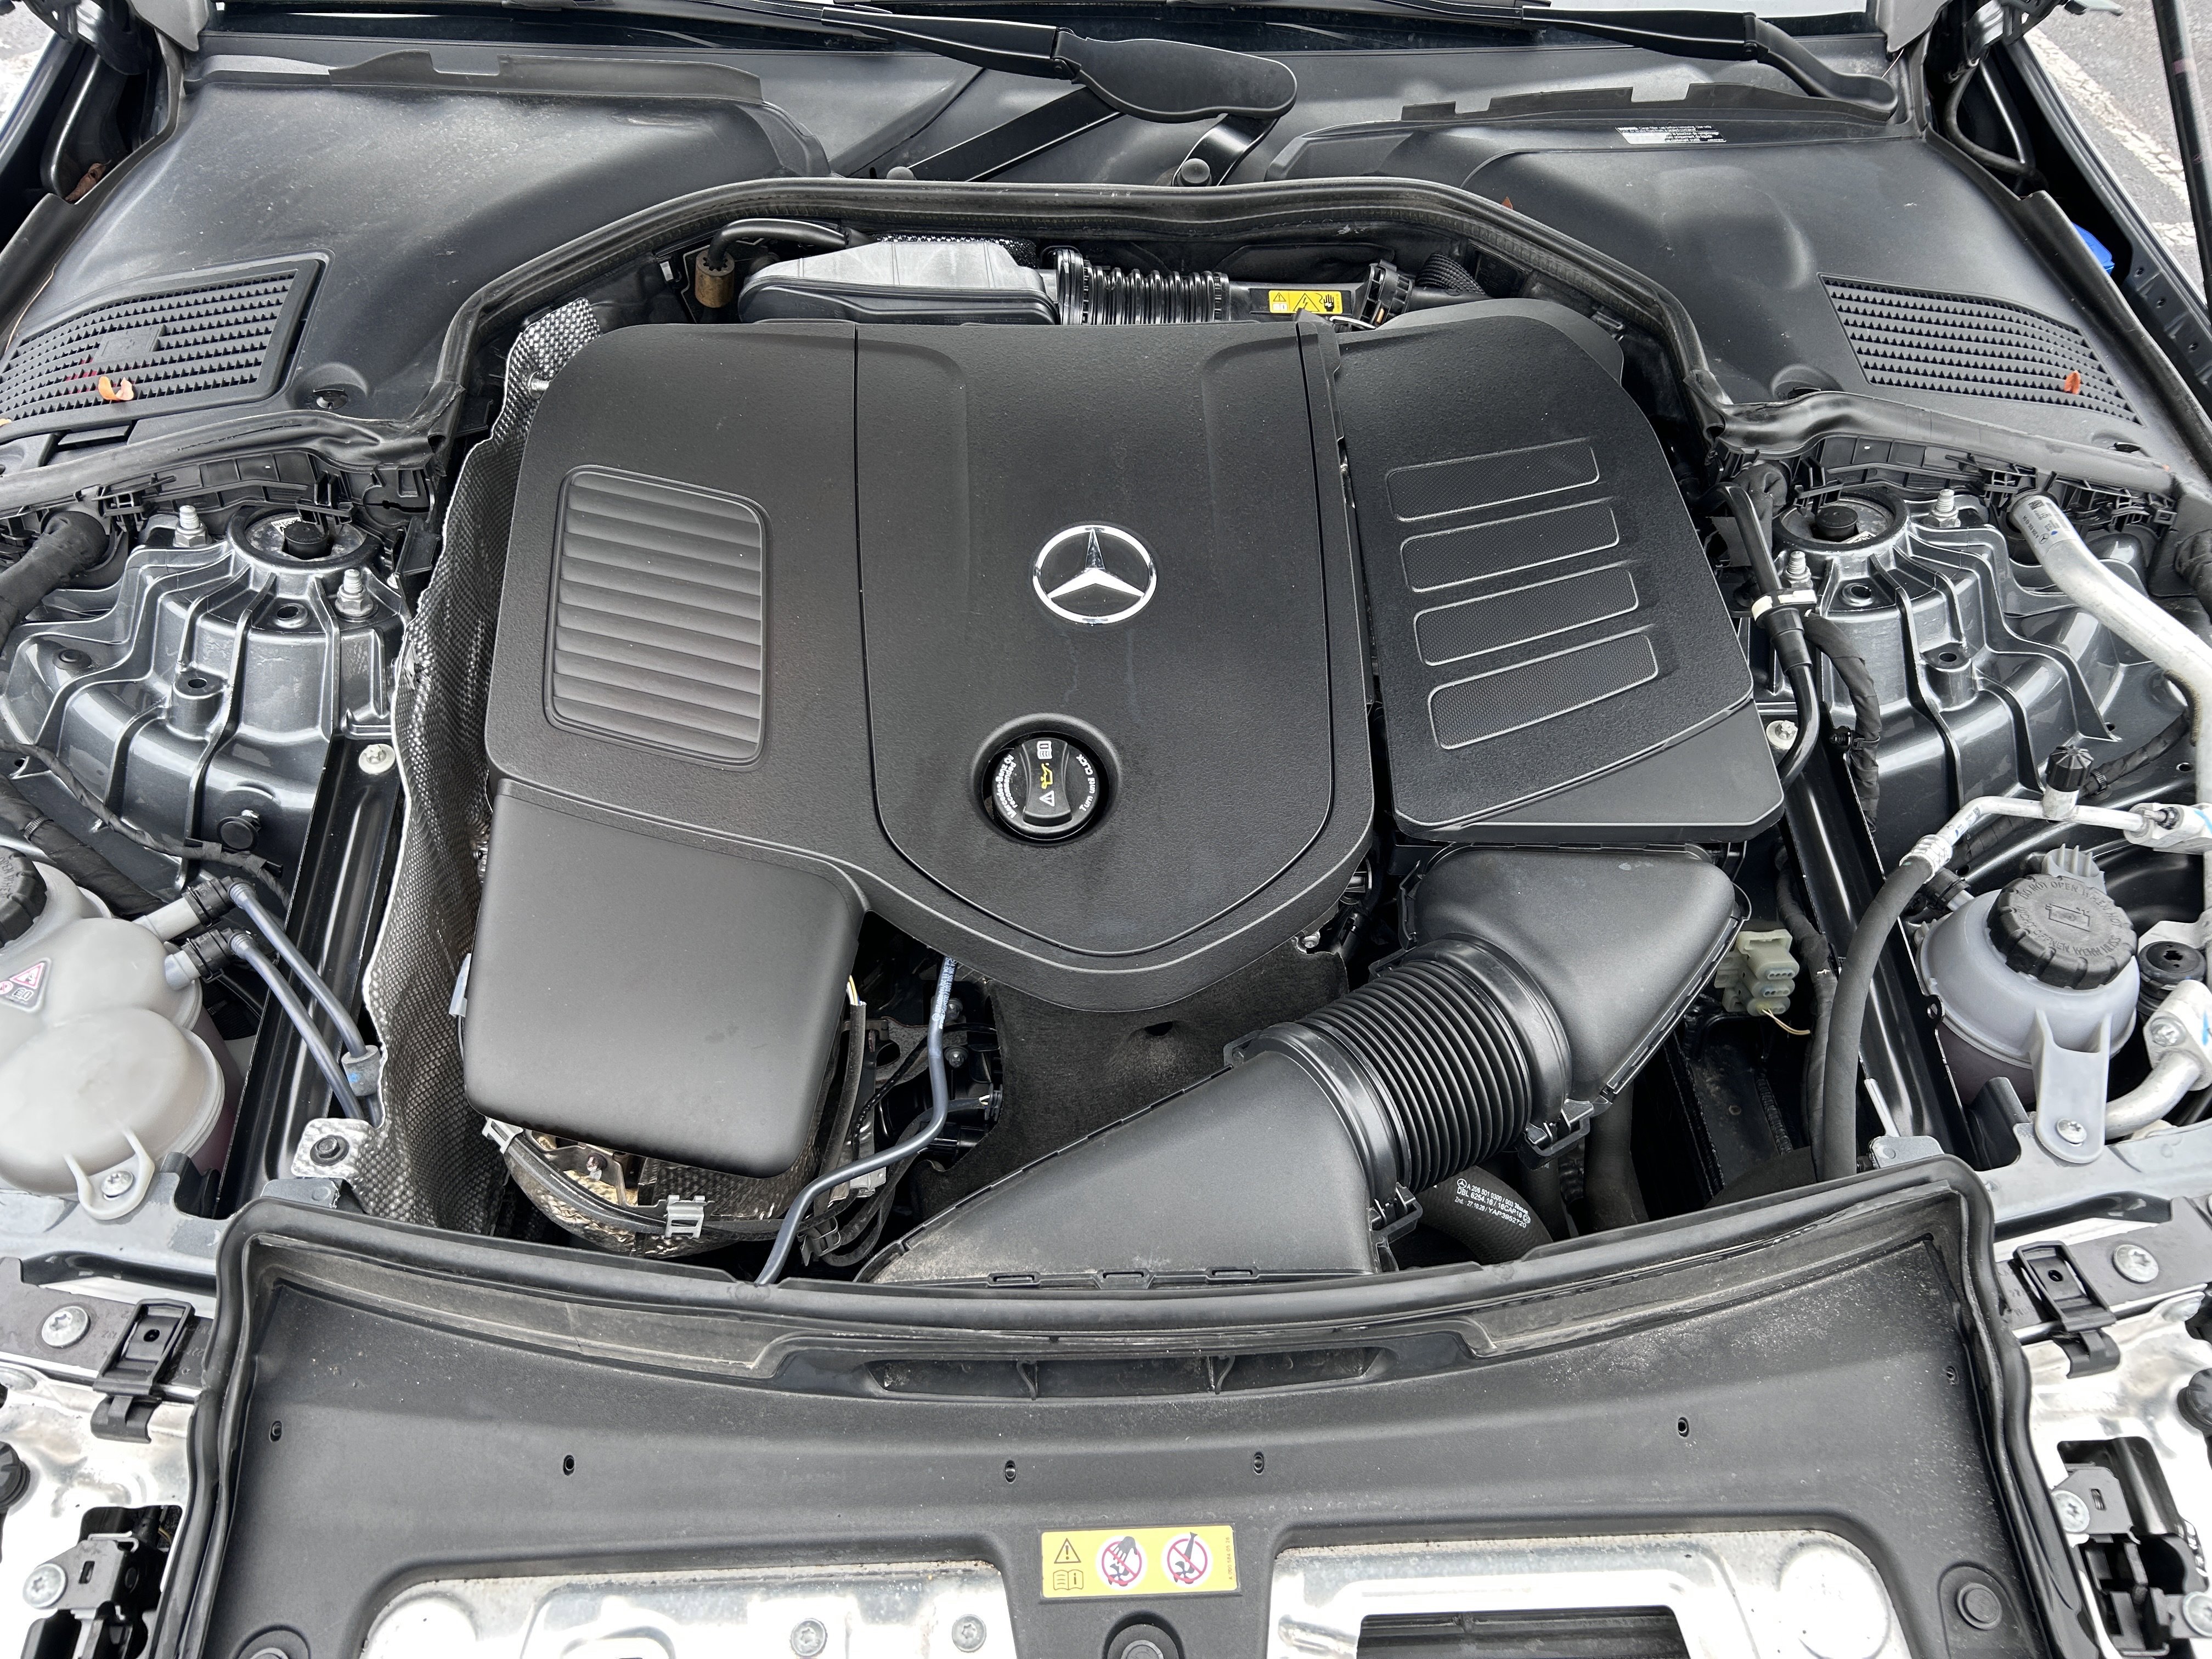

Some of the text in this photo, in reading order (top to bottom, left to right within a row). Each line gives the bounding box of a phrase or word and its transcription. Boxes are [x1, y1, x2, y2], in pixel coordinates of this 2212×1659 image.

[995, 763, 1017, 819] Mercedes-Benz
[1003, 761, 1018, 809] recommended
[1076, 753, 1096, 811] Turn until CLICK
[2019, 881, 2123, 928] DO NOT OPEN WHEN HOT
[1457, 1187, 1469, 1197] DBL
[1470, 1192, 1494, 1205] 6254.16
[1471, 1185, 1481, 1194] 206
[1481, 1188, 1490, 1197] 501
